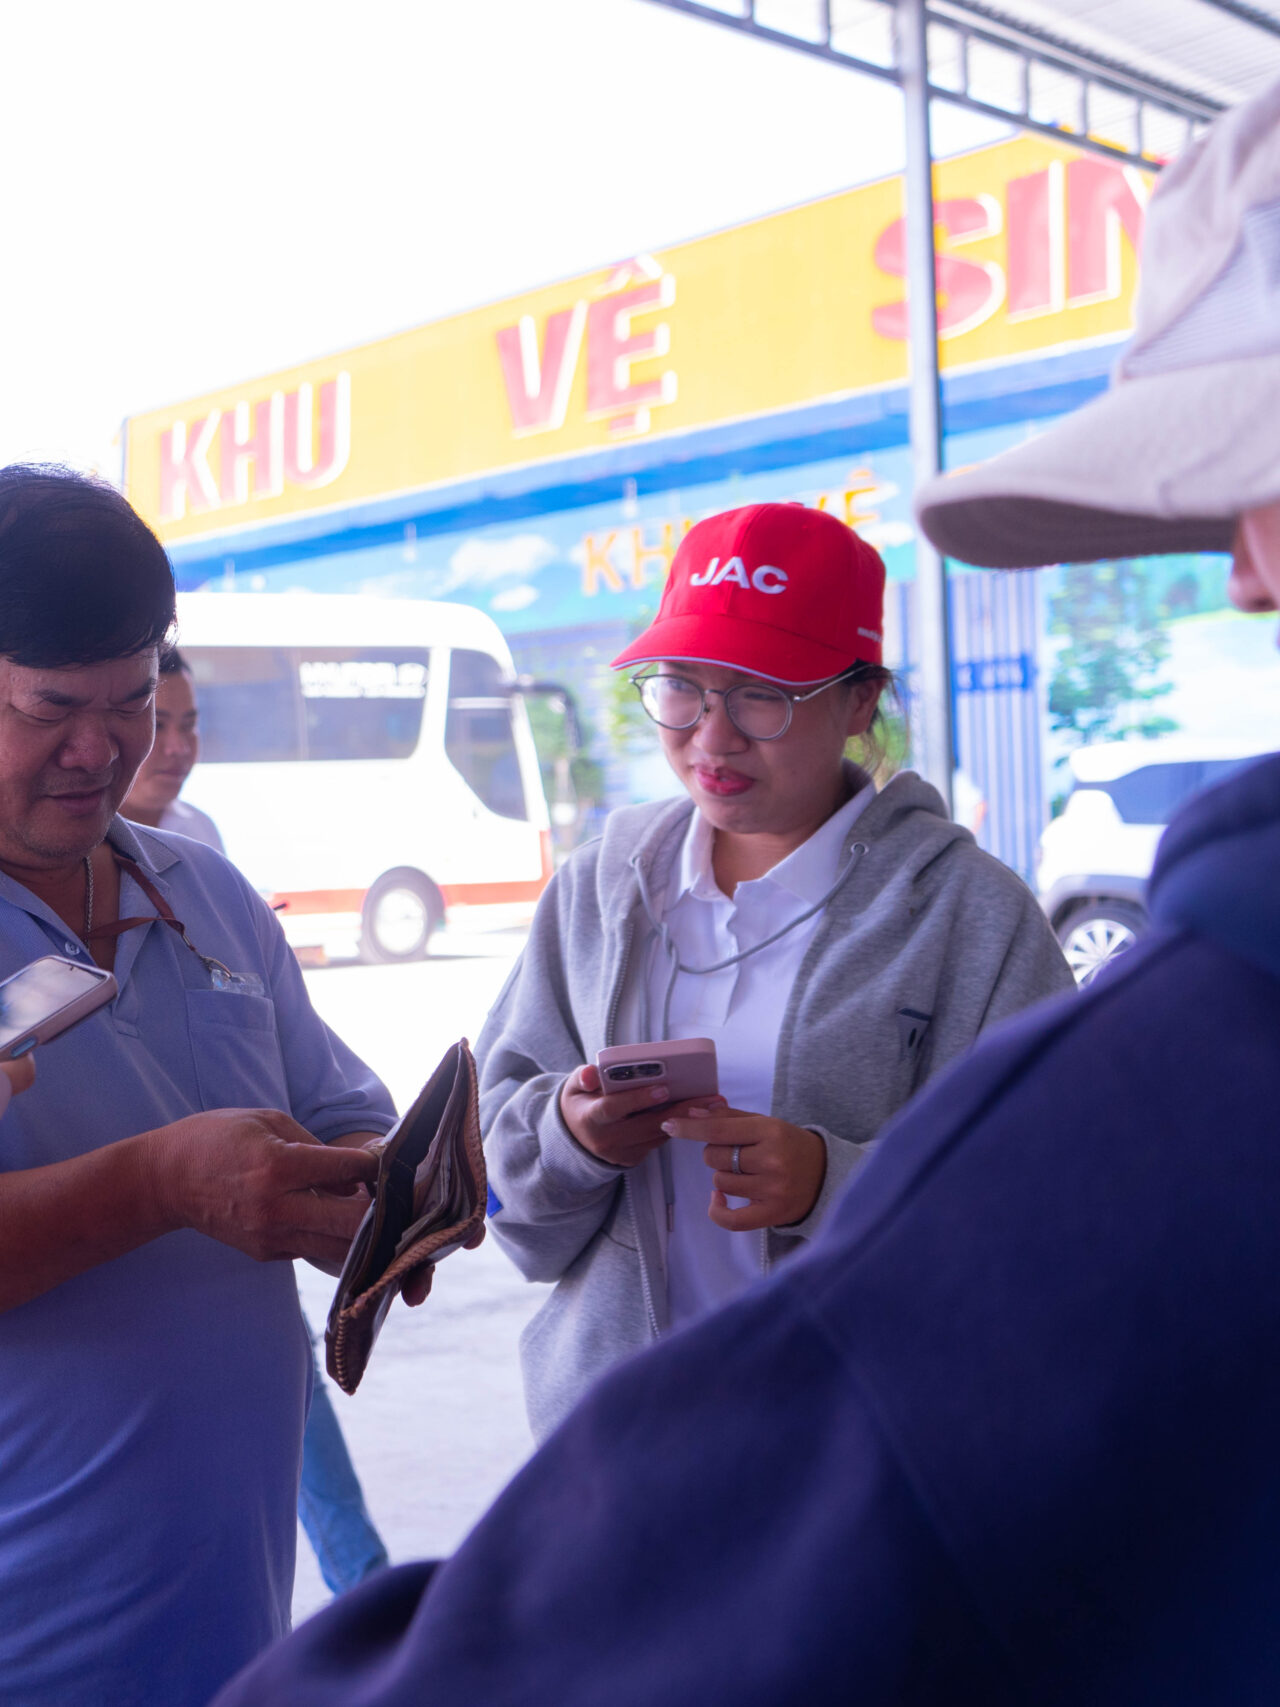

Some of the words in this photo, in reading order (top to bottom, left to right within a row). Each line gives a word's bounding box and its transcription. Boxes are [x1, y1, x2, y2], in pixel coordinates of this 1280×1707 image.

[157, 370, 352, 522] KHU
[493, 253, 677, 438] VỆ
[581, 519, 694, 596] KH
[690, 556, 789, 595] JAC
